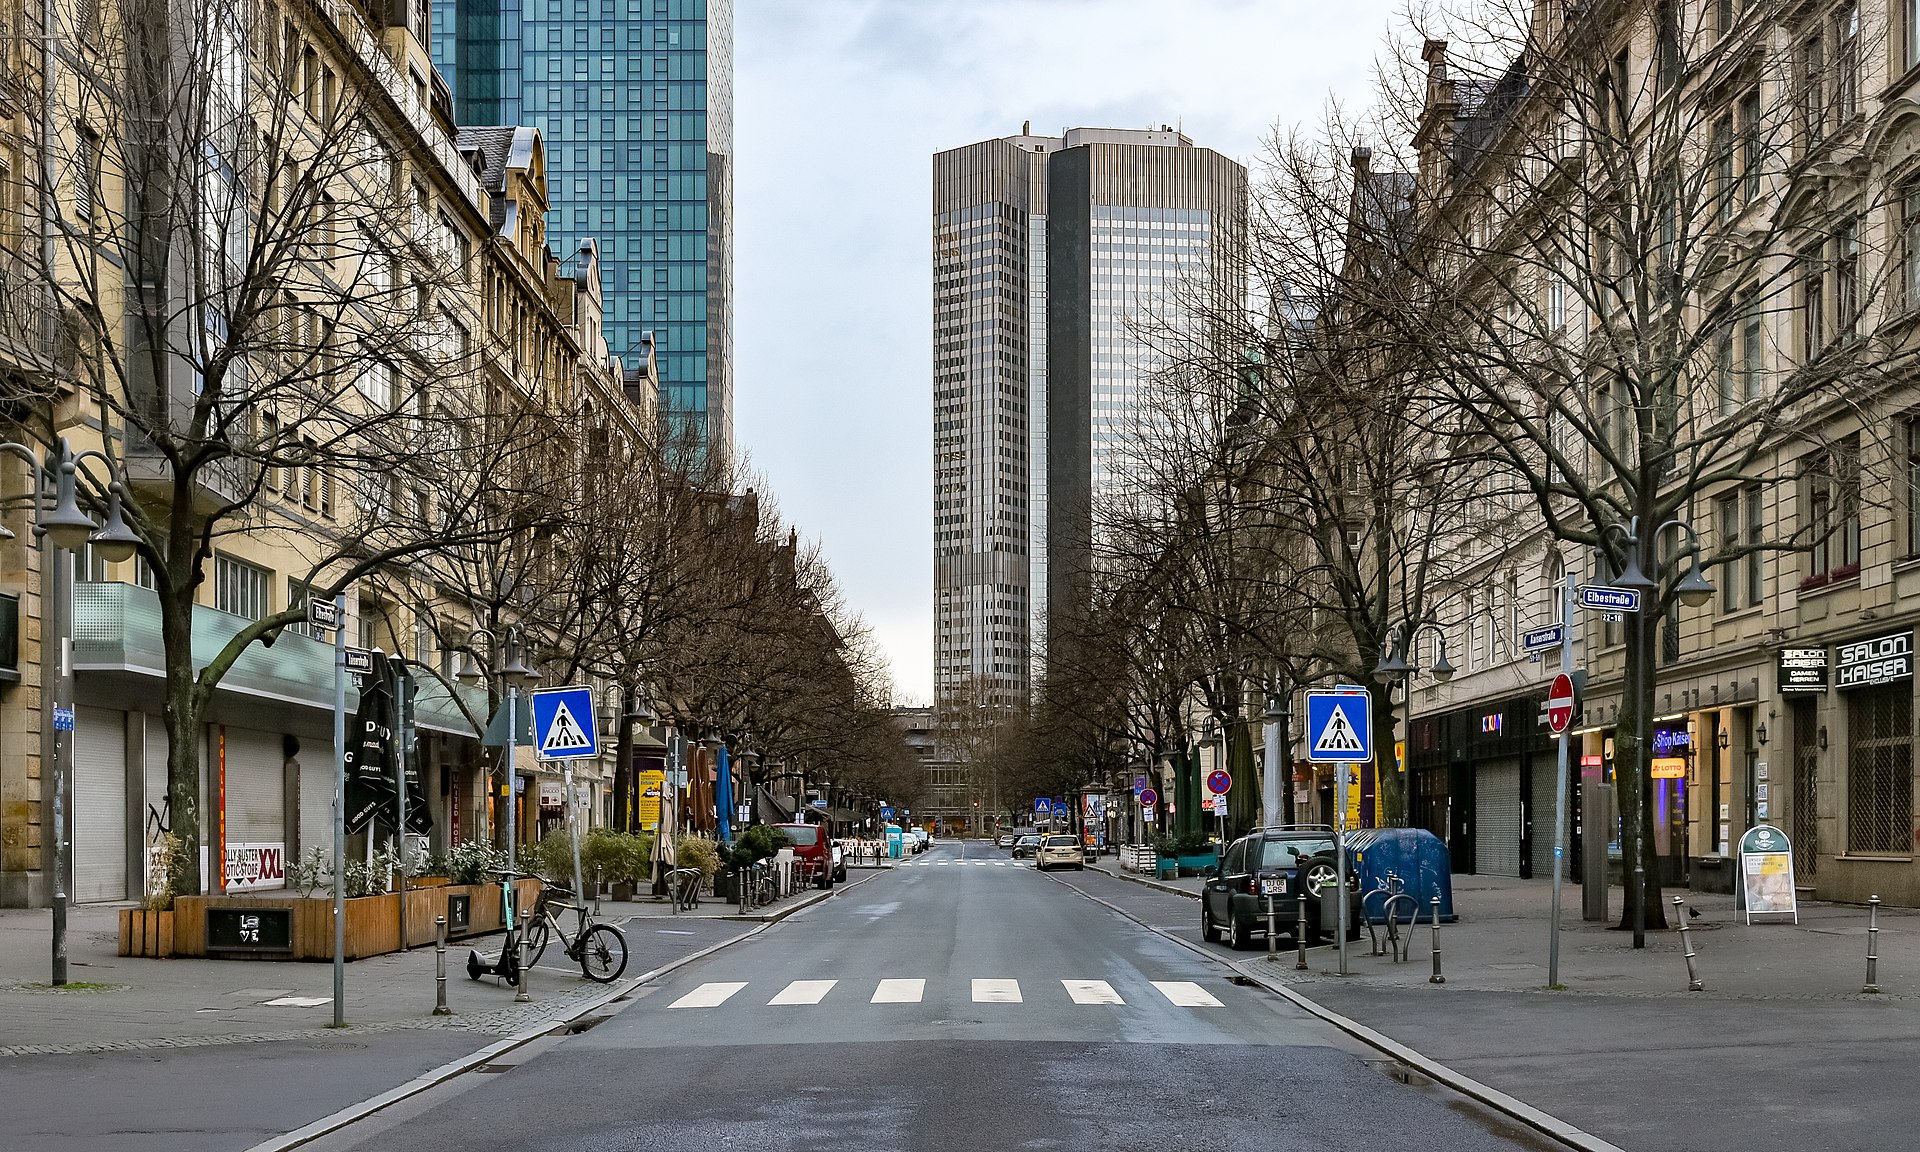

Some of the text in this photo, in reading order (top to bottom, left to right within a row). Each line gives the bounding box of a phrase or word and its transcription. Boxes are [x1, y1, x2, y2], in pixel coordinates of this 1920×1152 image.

[1587, 591, 1630, 605] Elbestraße
[1530, 630, 1556, 645] Kaiserstraße
[1783, 650, 1825, 658] SALON
[1841, 636, 1907, 664] SALON
[1783, 659, 1825, 667] KAISER
[1840, 658, 1907, 684] KAISER
[259, 848, 284, 880] XXL
